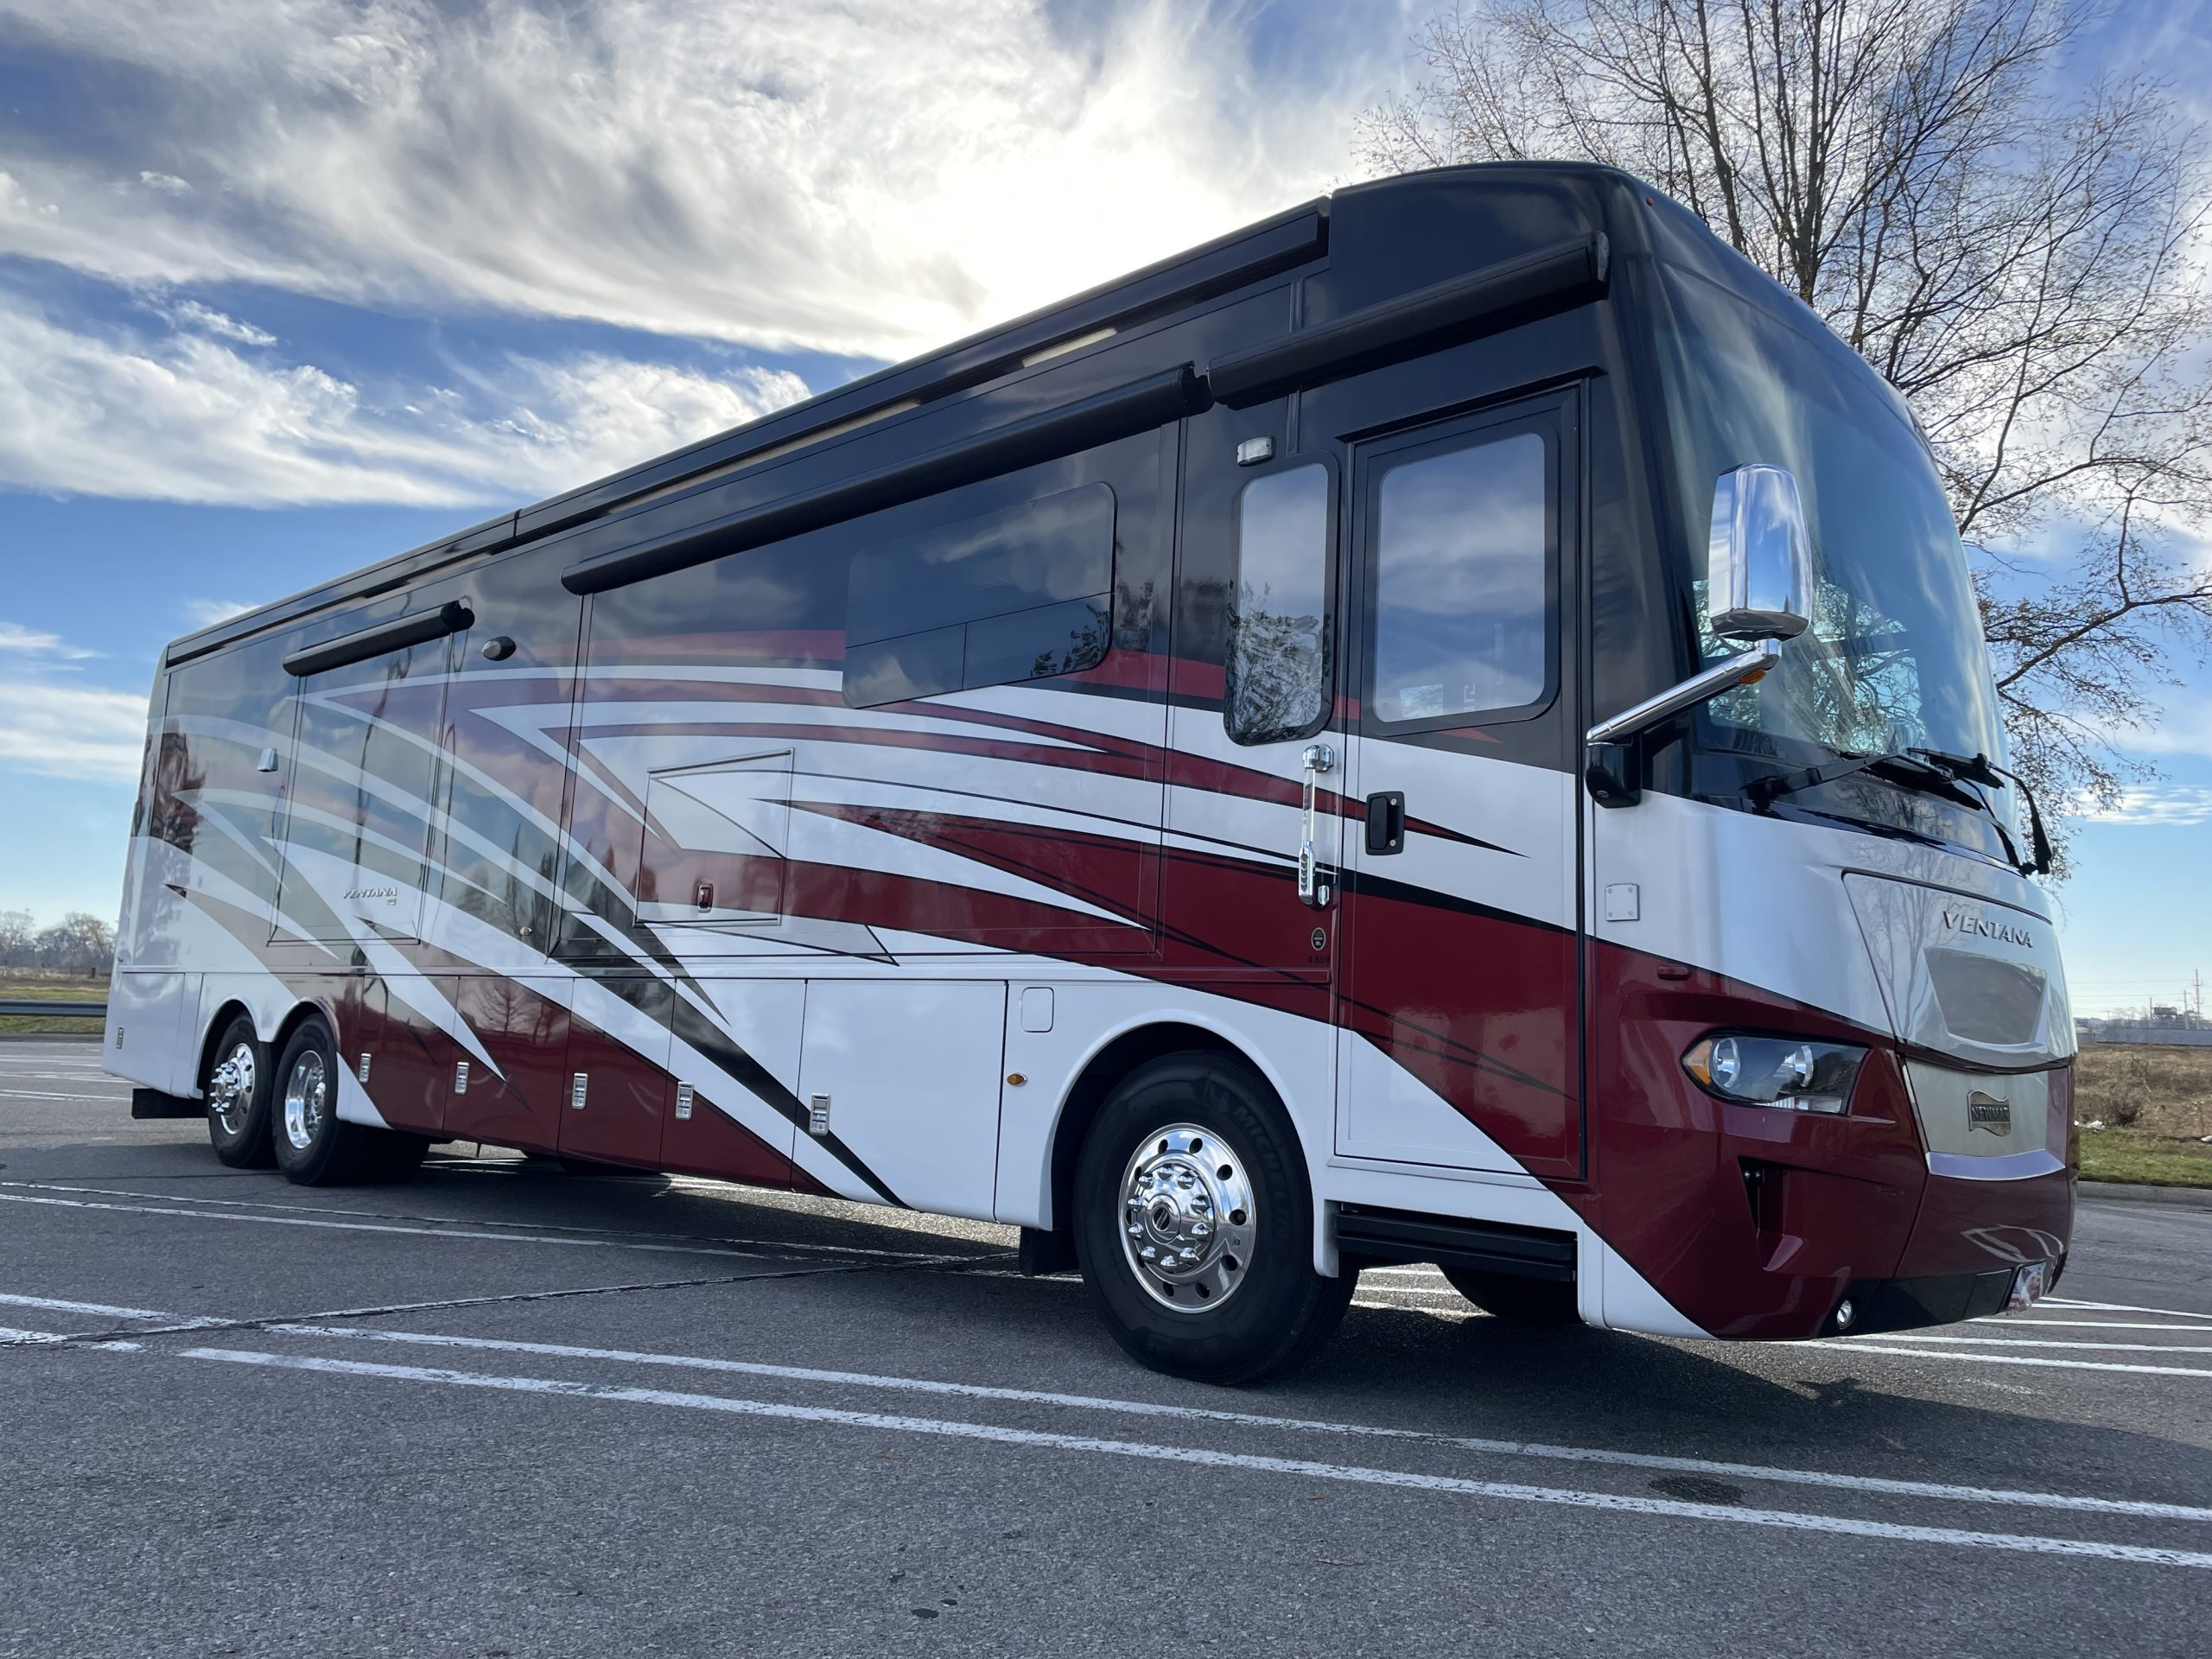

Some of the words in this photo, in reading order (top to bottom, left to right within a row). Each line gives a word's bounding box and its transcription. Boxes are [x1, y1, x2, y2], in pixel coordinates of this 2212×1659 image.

[343, 887, 397, 899] VENTANA
[1942, 911, 2033, 948] VENTANA
[1971, 1106, 2009, 1121] NEWMAR
